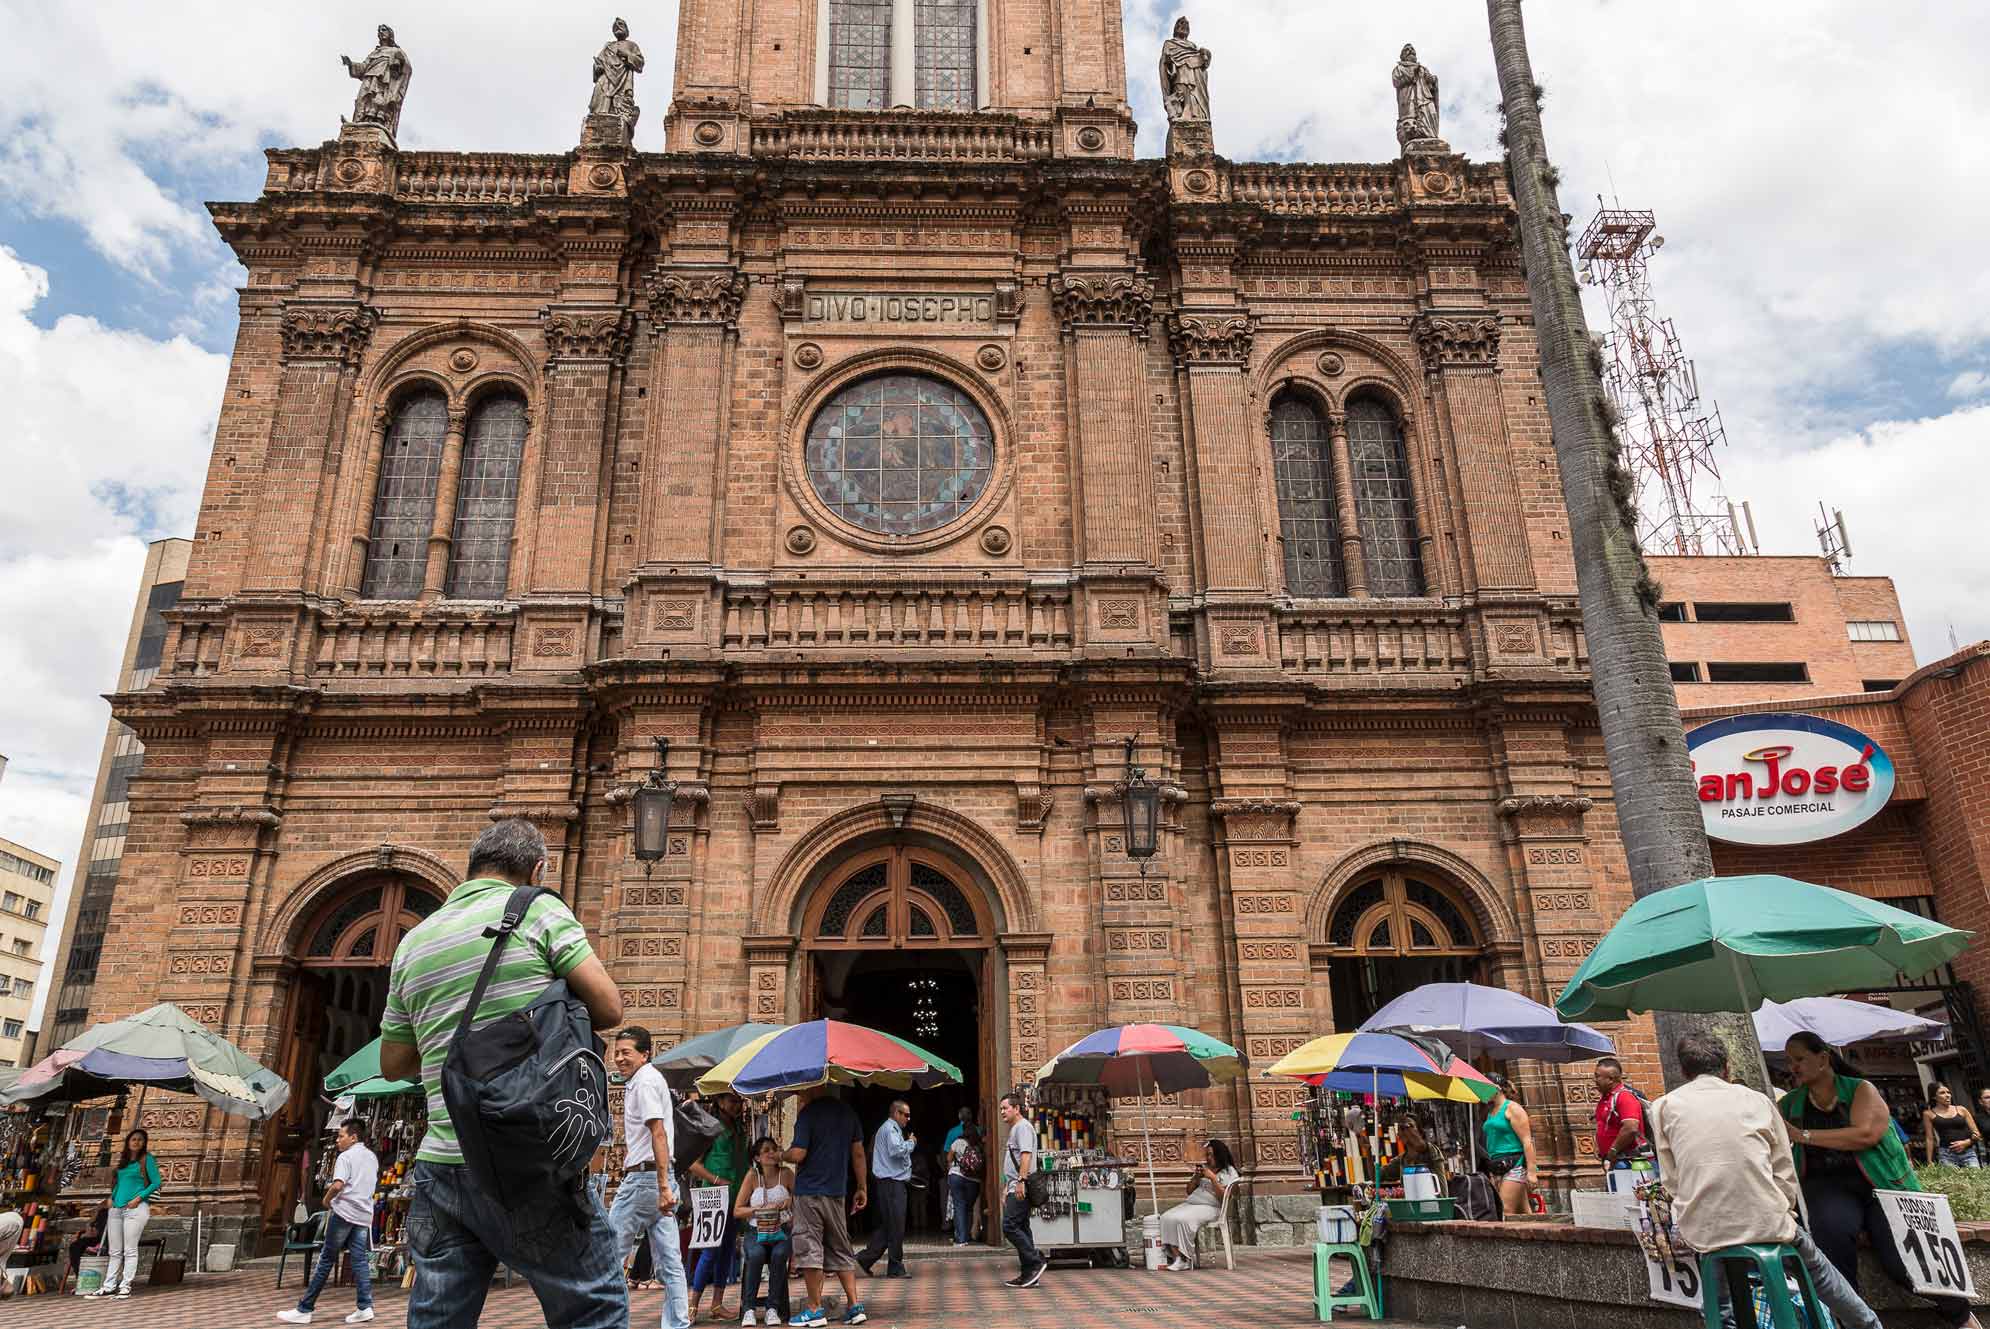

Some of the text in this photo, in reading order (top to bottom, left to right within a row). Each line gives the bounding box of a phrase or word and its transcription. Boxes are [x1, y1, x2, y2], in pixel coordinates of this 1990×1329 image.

[808, 297, 992, 322] DIVO IOSEPHO
[1690, 744, 1876, 802] an José
[1721, 802, 1836, 819] PASAJE COMERCIAL
[696, 1209, 725, 1242] 150
[1903, 1228, 1966, 1291] 150
